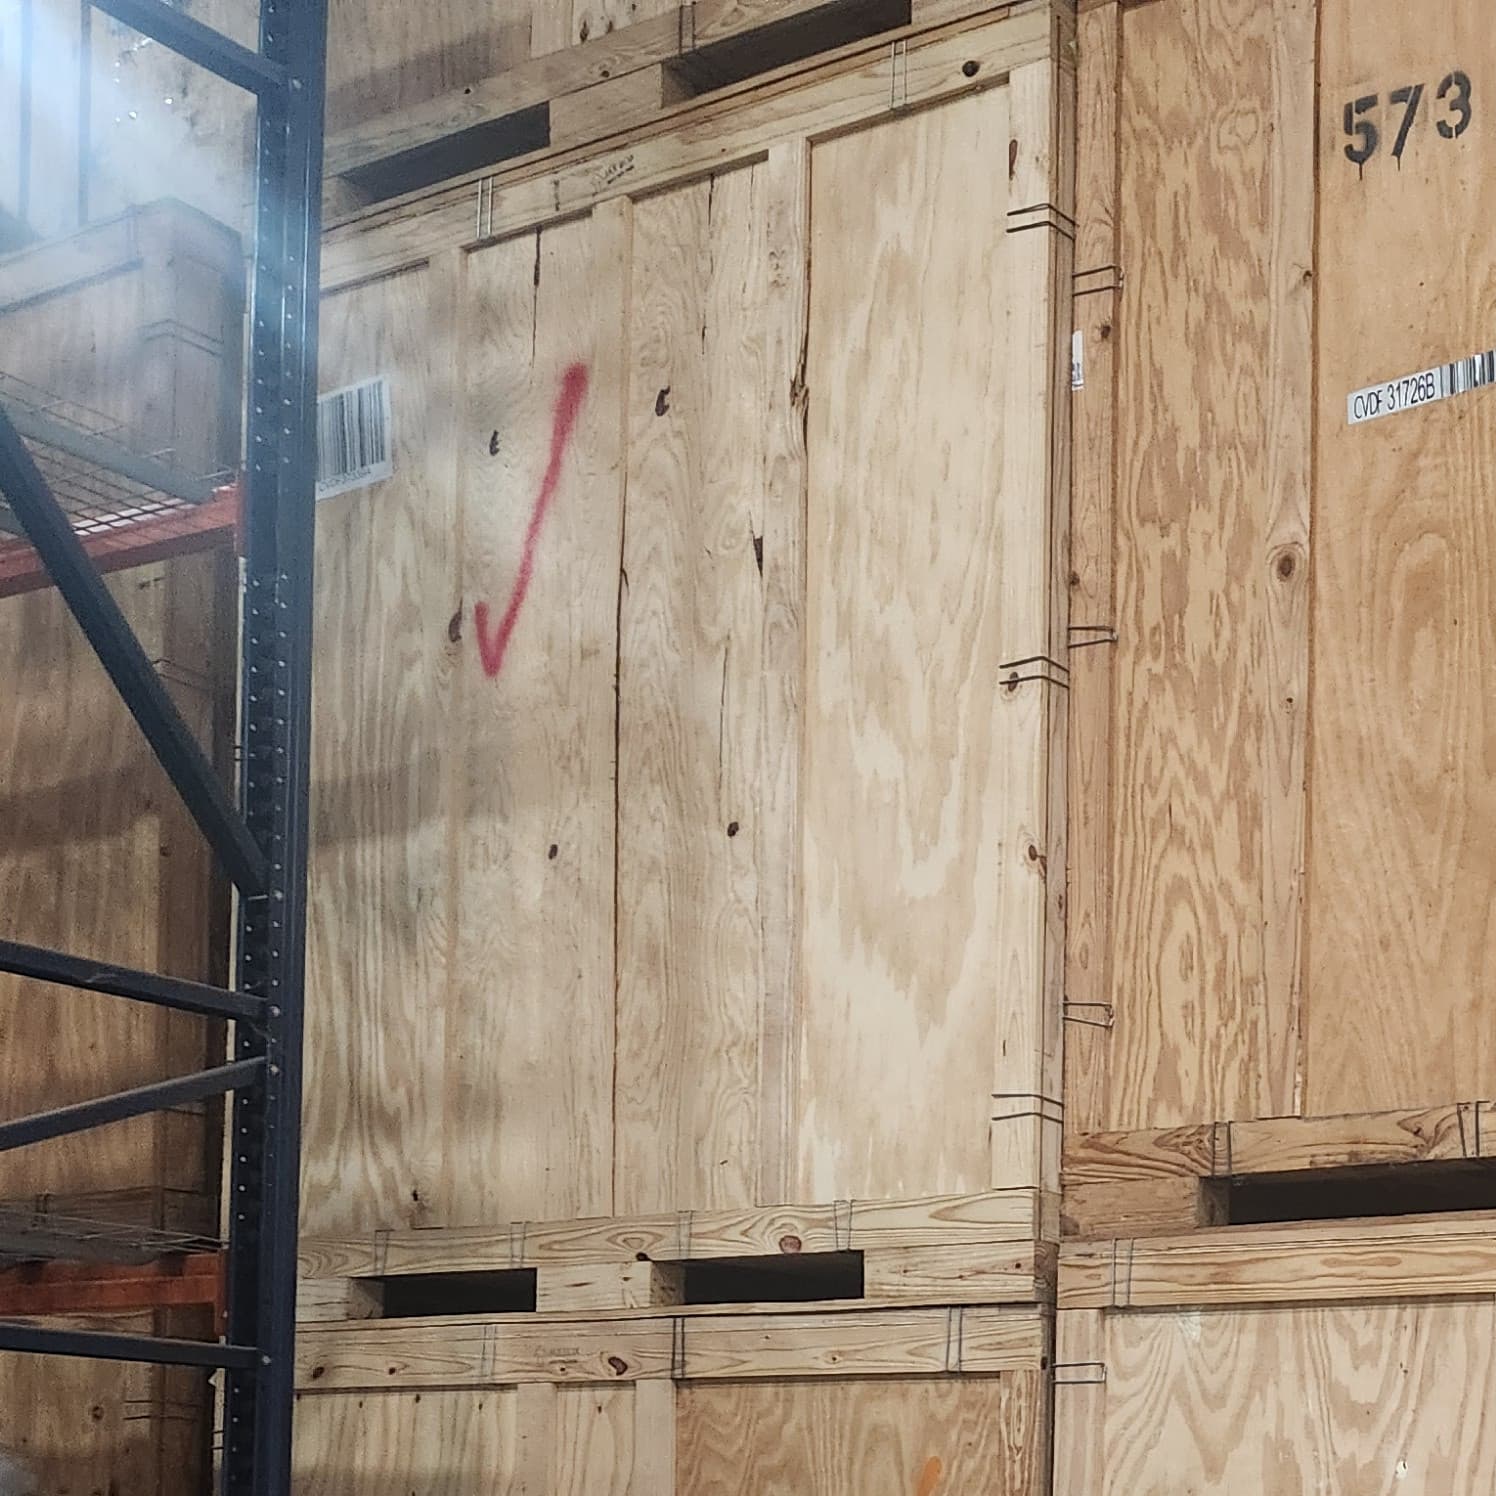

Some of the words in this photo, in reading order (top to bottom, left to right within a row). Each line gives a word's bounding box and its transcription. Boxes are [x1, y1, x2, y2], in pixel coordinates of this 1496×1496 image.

[1343, 70, 1472, 167] 573
[1353, 387, 1383, 419] CVDF
[1387, 372, 1436, 411] 31726B
